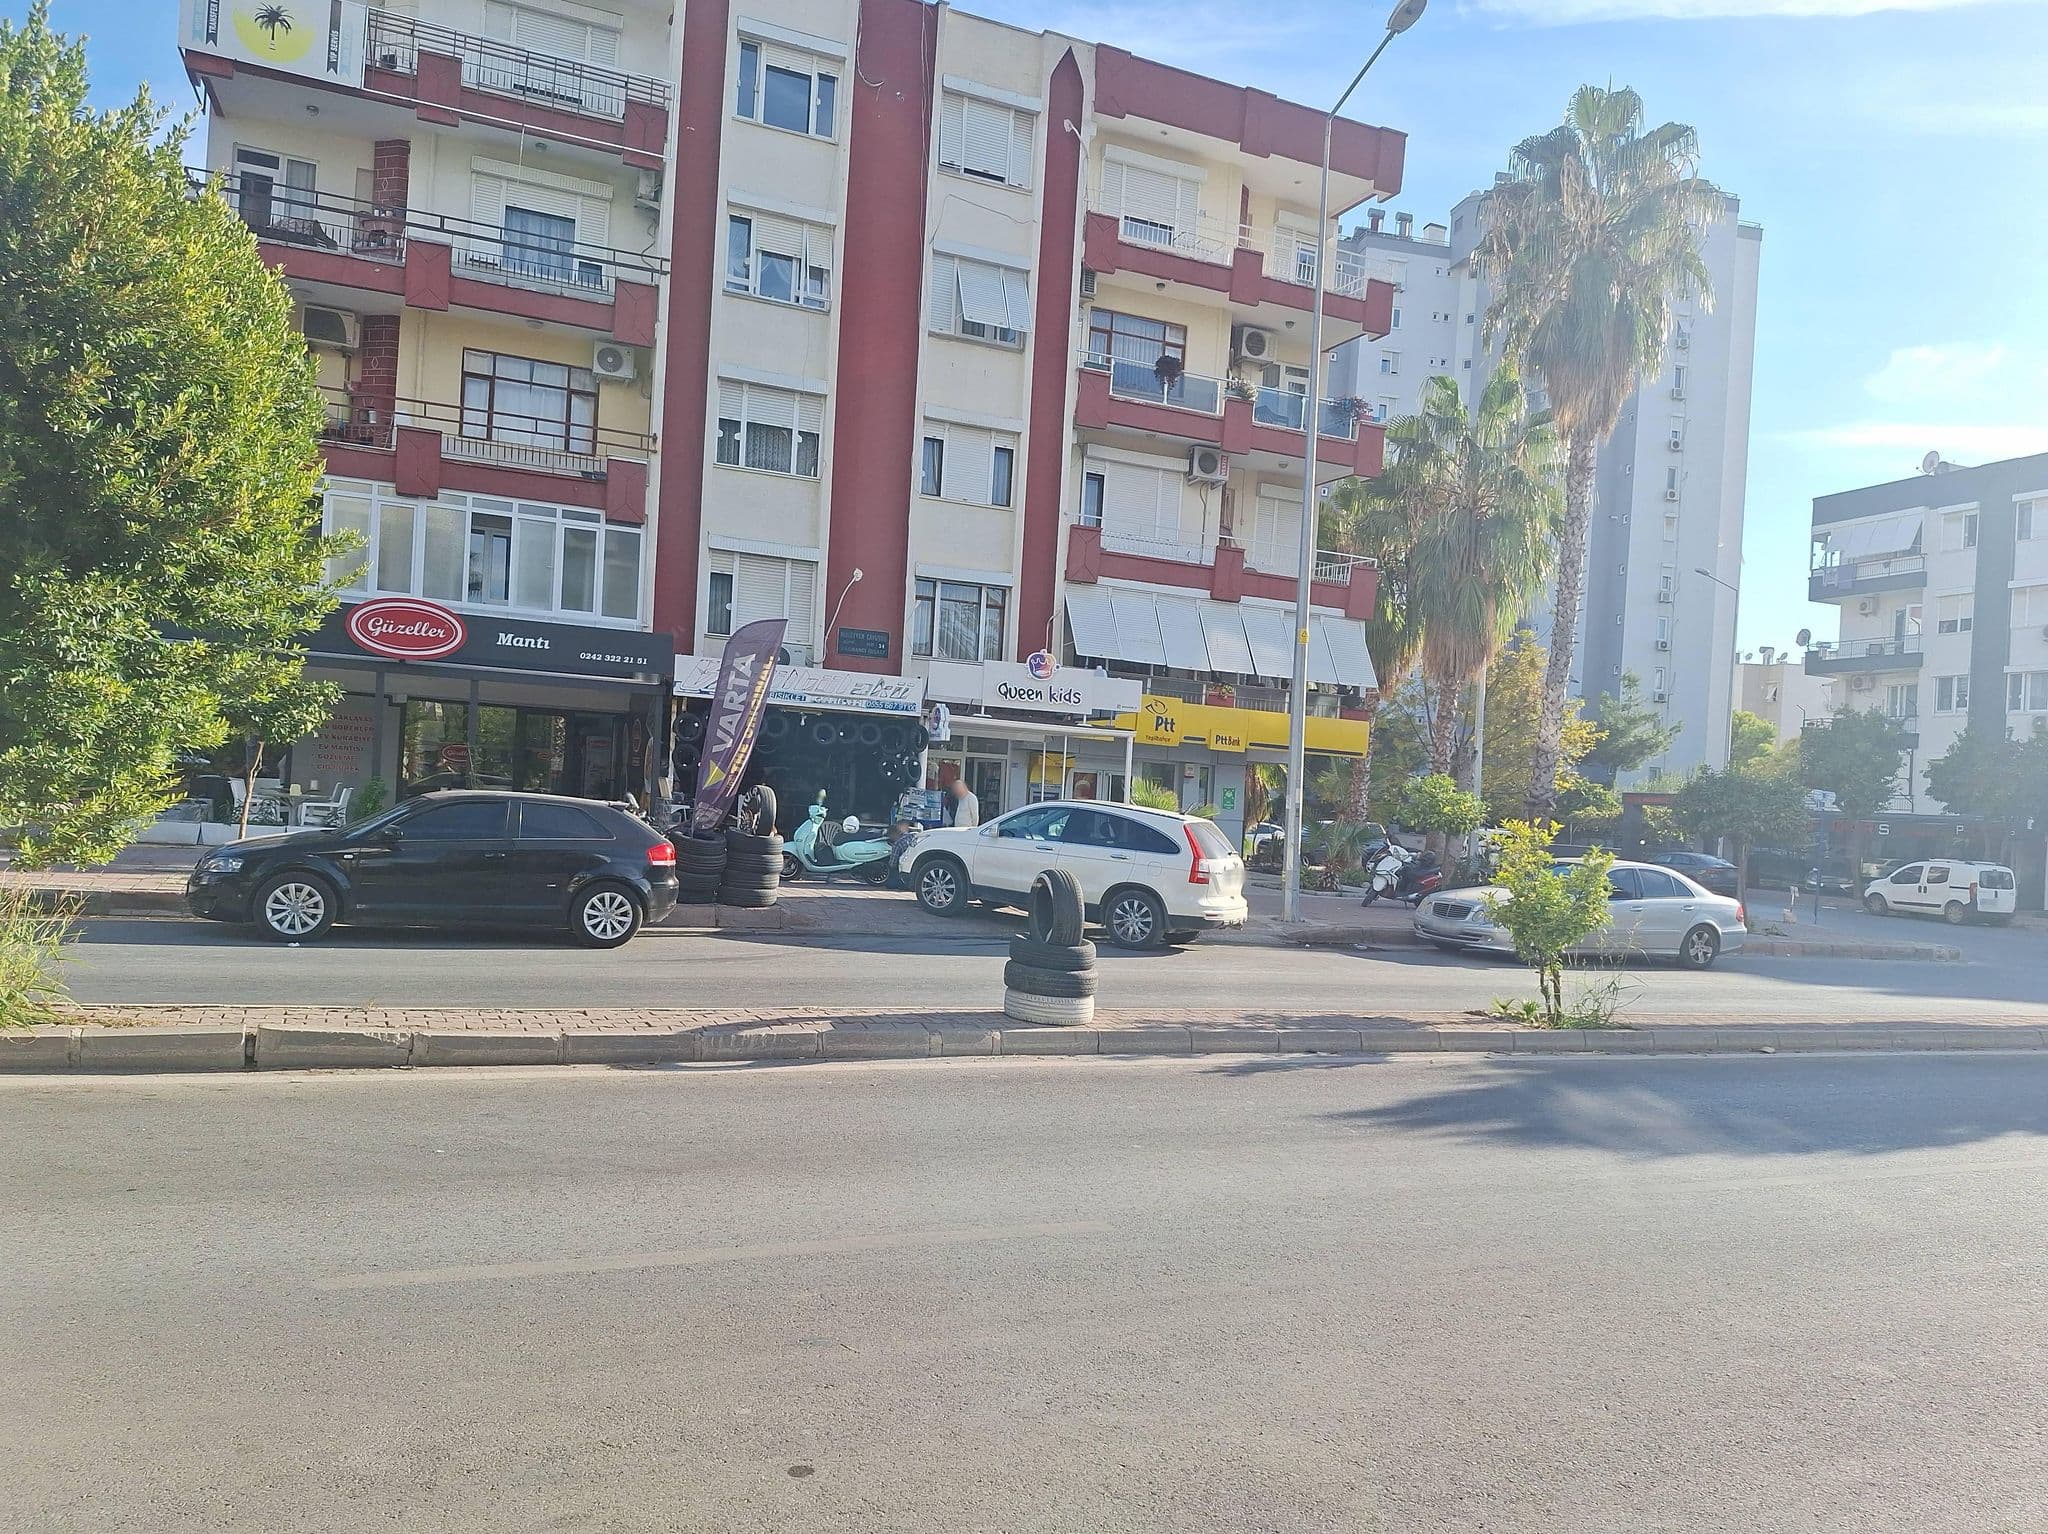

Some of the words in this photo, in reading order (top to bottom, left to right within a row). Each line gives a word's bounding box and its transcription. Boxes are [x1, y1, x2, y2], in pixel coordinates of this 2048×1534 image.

[208, 3, 218, 34] TRANSFER
[367, 616, 446, 638] Güzeller
[496, 632, 550, 650] Mantı
[579, 652, 603, 661] 0242
[604, 654, 621, 662] 322
[623, 655, 634, 664] 21
[636, 657, 648, 665] 51
[711, 653, 757, 753] VARTA
[997, 681, 1044, 701] Queen
[1048, 685, 1083, 705] kids
[1154, 715, 1176, 733] Ptt
